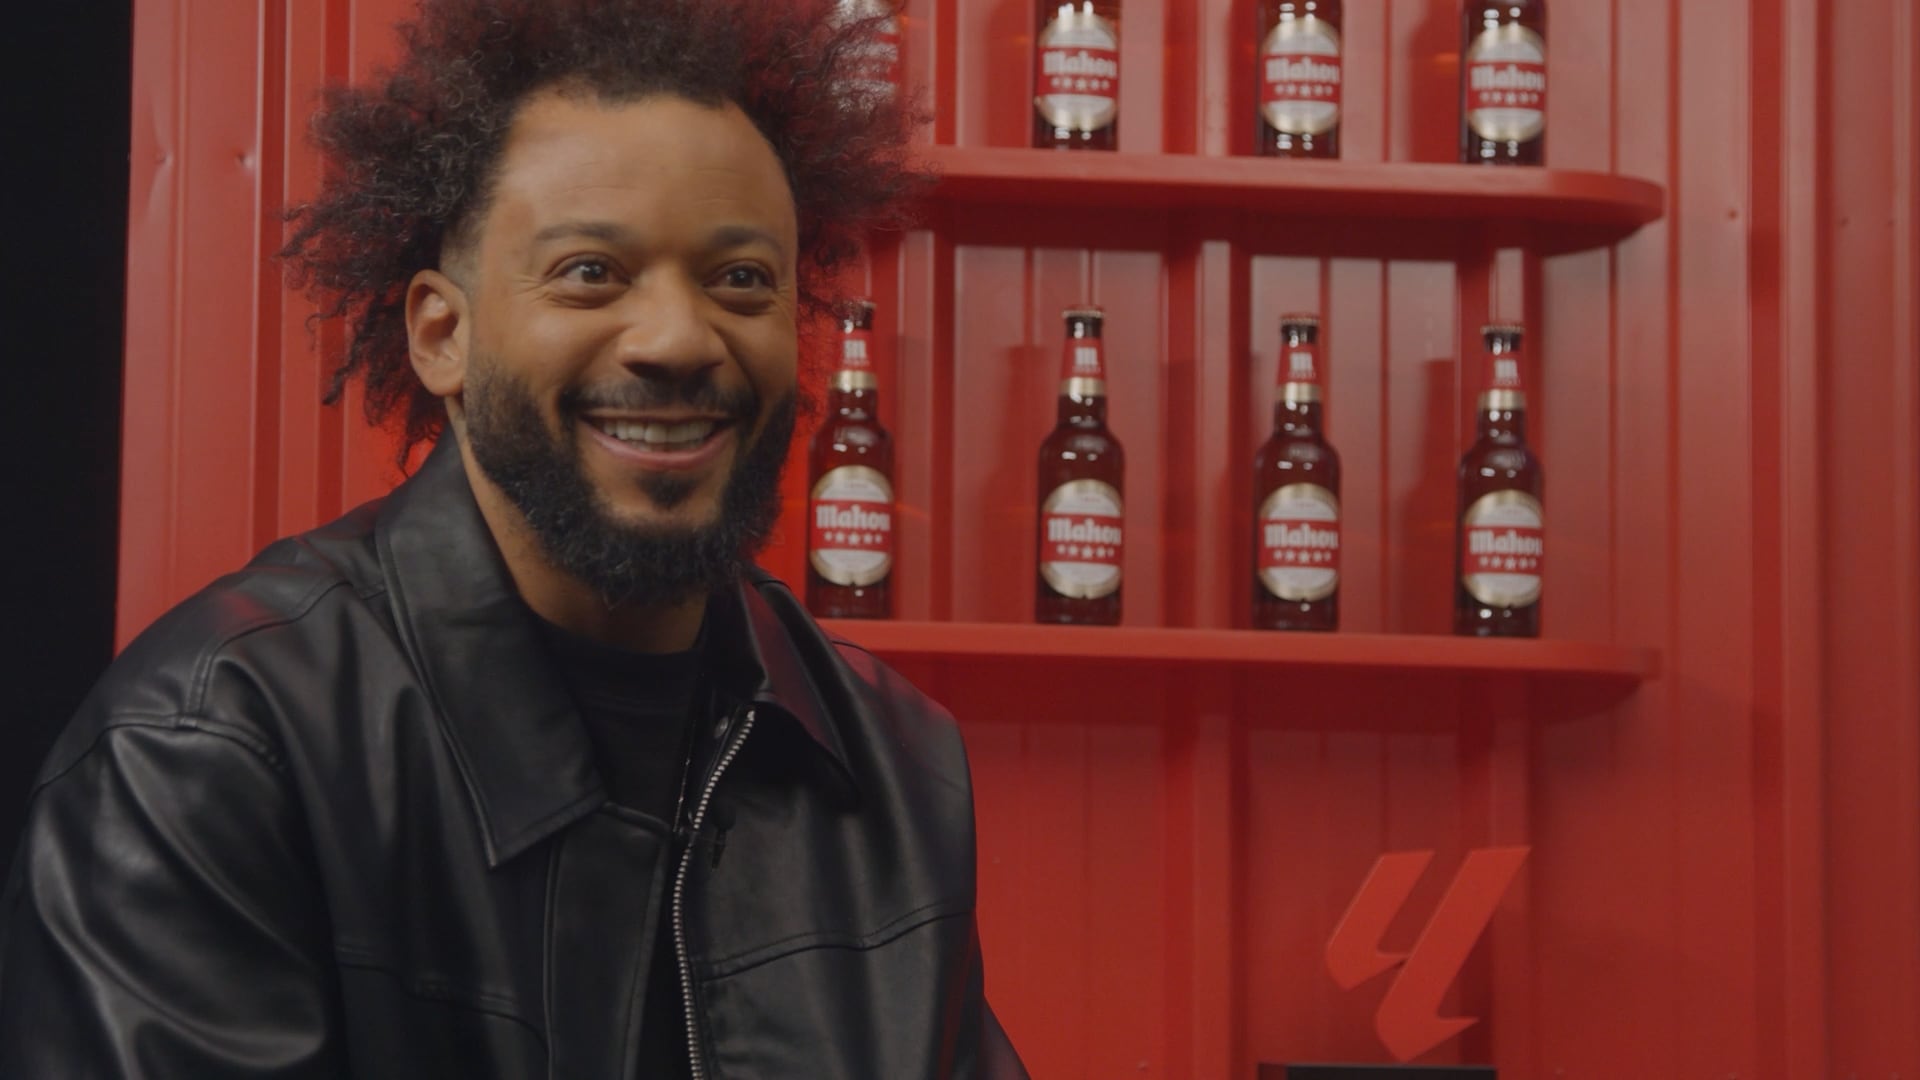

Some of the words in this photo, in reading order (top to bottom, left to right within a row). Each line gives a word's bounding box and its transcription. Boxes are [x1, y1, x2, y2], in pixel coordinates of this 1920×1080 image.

[1043, 50, 1117, 77] Mahou
[816, 504, 890, 531] Mahou
[1048, 518, 1122, 545] Mahou
[1264, 523, 1338, 548] Mahou
[1469, 530, 1543, 556] Mahou
